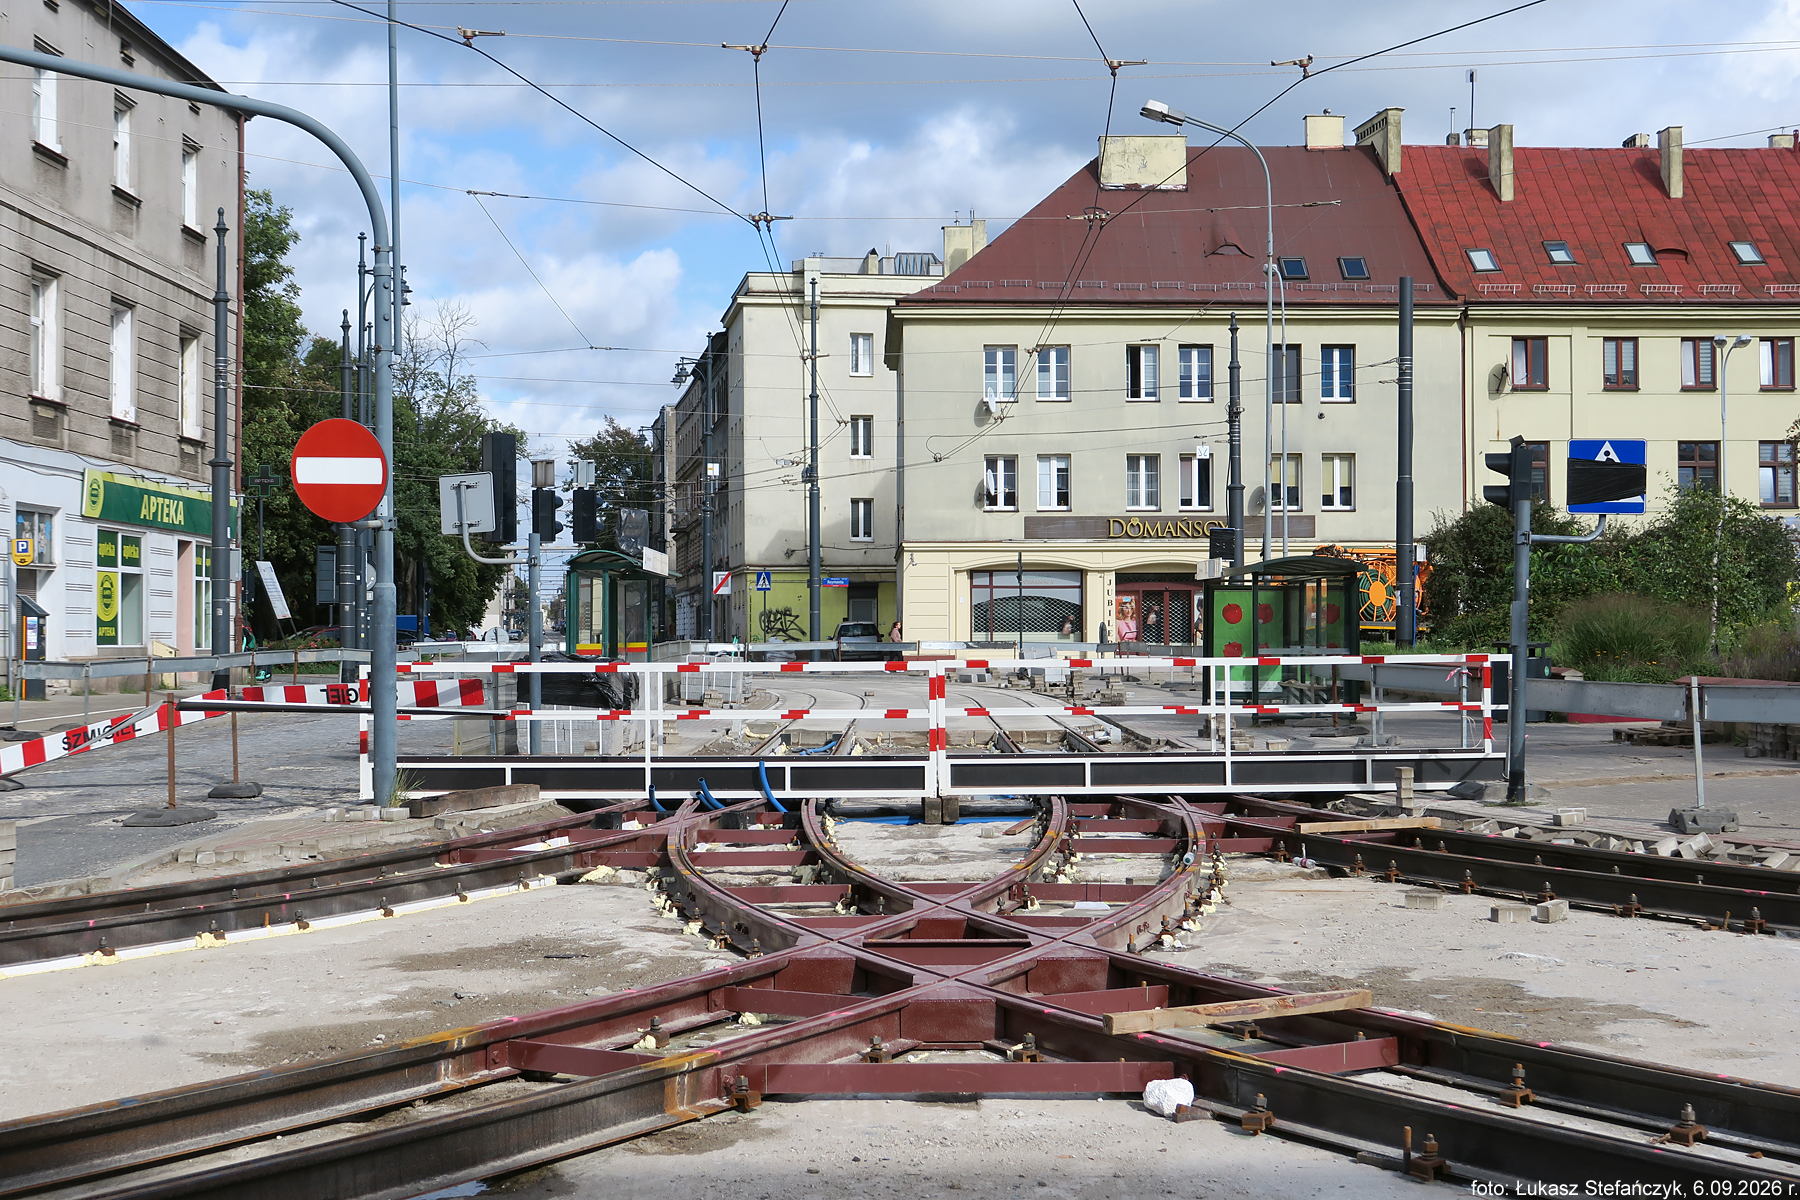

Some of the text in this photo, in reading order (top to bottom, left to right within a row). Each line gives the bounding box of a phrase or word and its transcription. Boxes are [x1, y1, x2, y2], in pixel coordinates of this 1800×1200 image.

[140, 494, 185, 525] APTEKA
[1106, 579, 1114, 643] JUBILE
[98, 627, 116, 637] APTEKA
